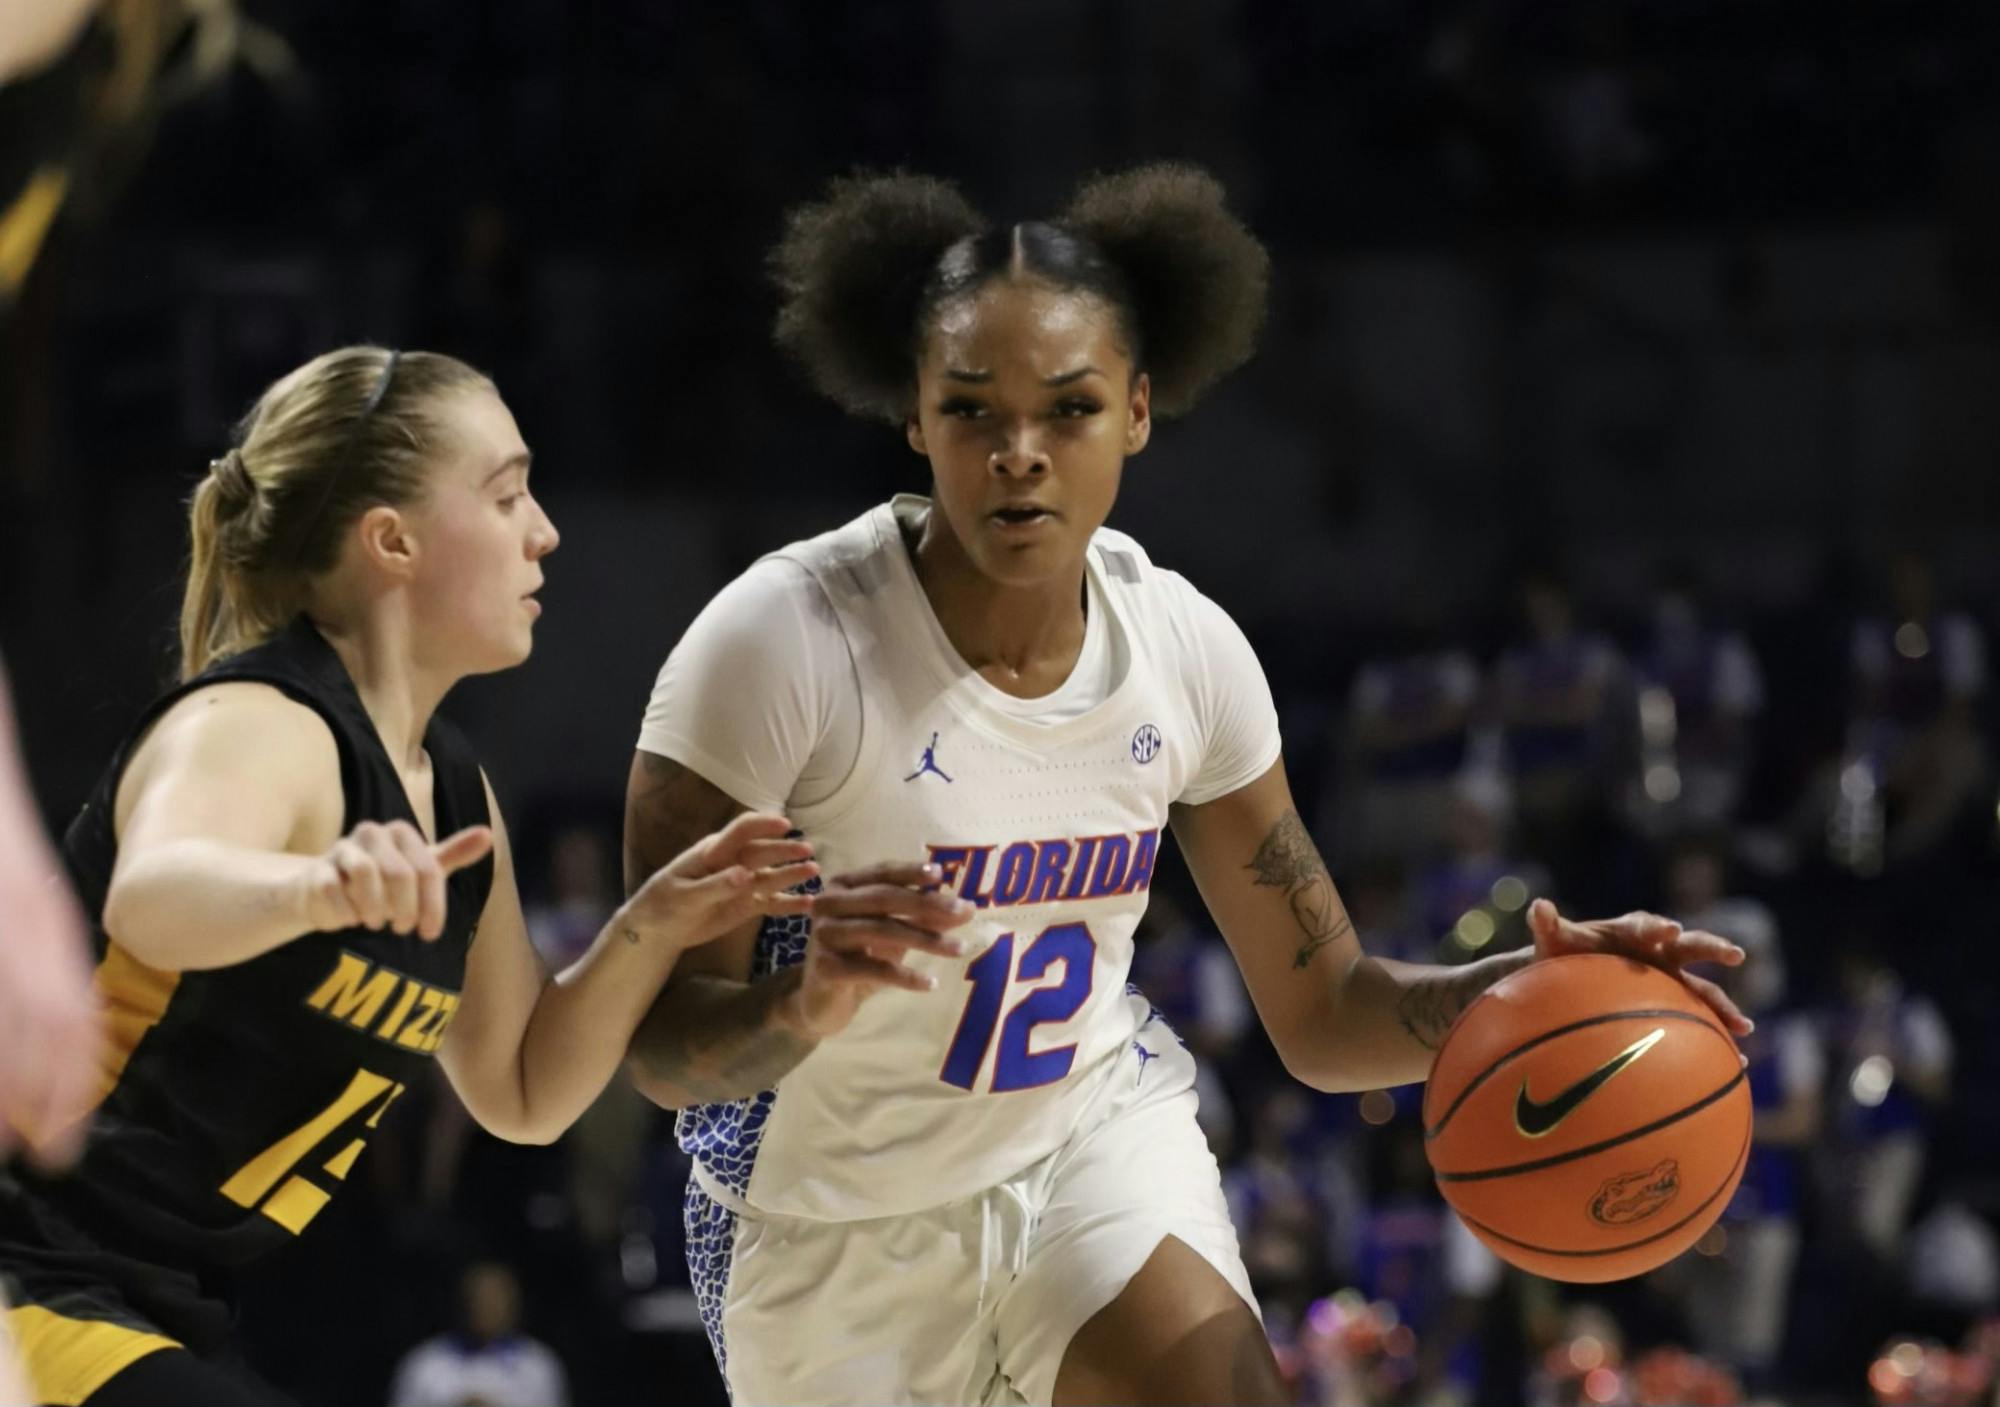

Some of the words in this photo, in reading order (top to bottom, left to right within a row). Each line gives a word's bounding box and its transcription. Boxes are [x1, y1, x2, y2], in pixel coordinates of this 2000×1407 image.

[1132, 725, 1161, 763] SEC
[925, 827, 1159, 909] FLORIDA
[307, 951, 460, 1055] MIZZ
[939, 921, 1096, 1093] 12
